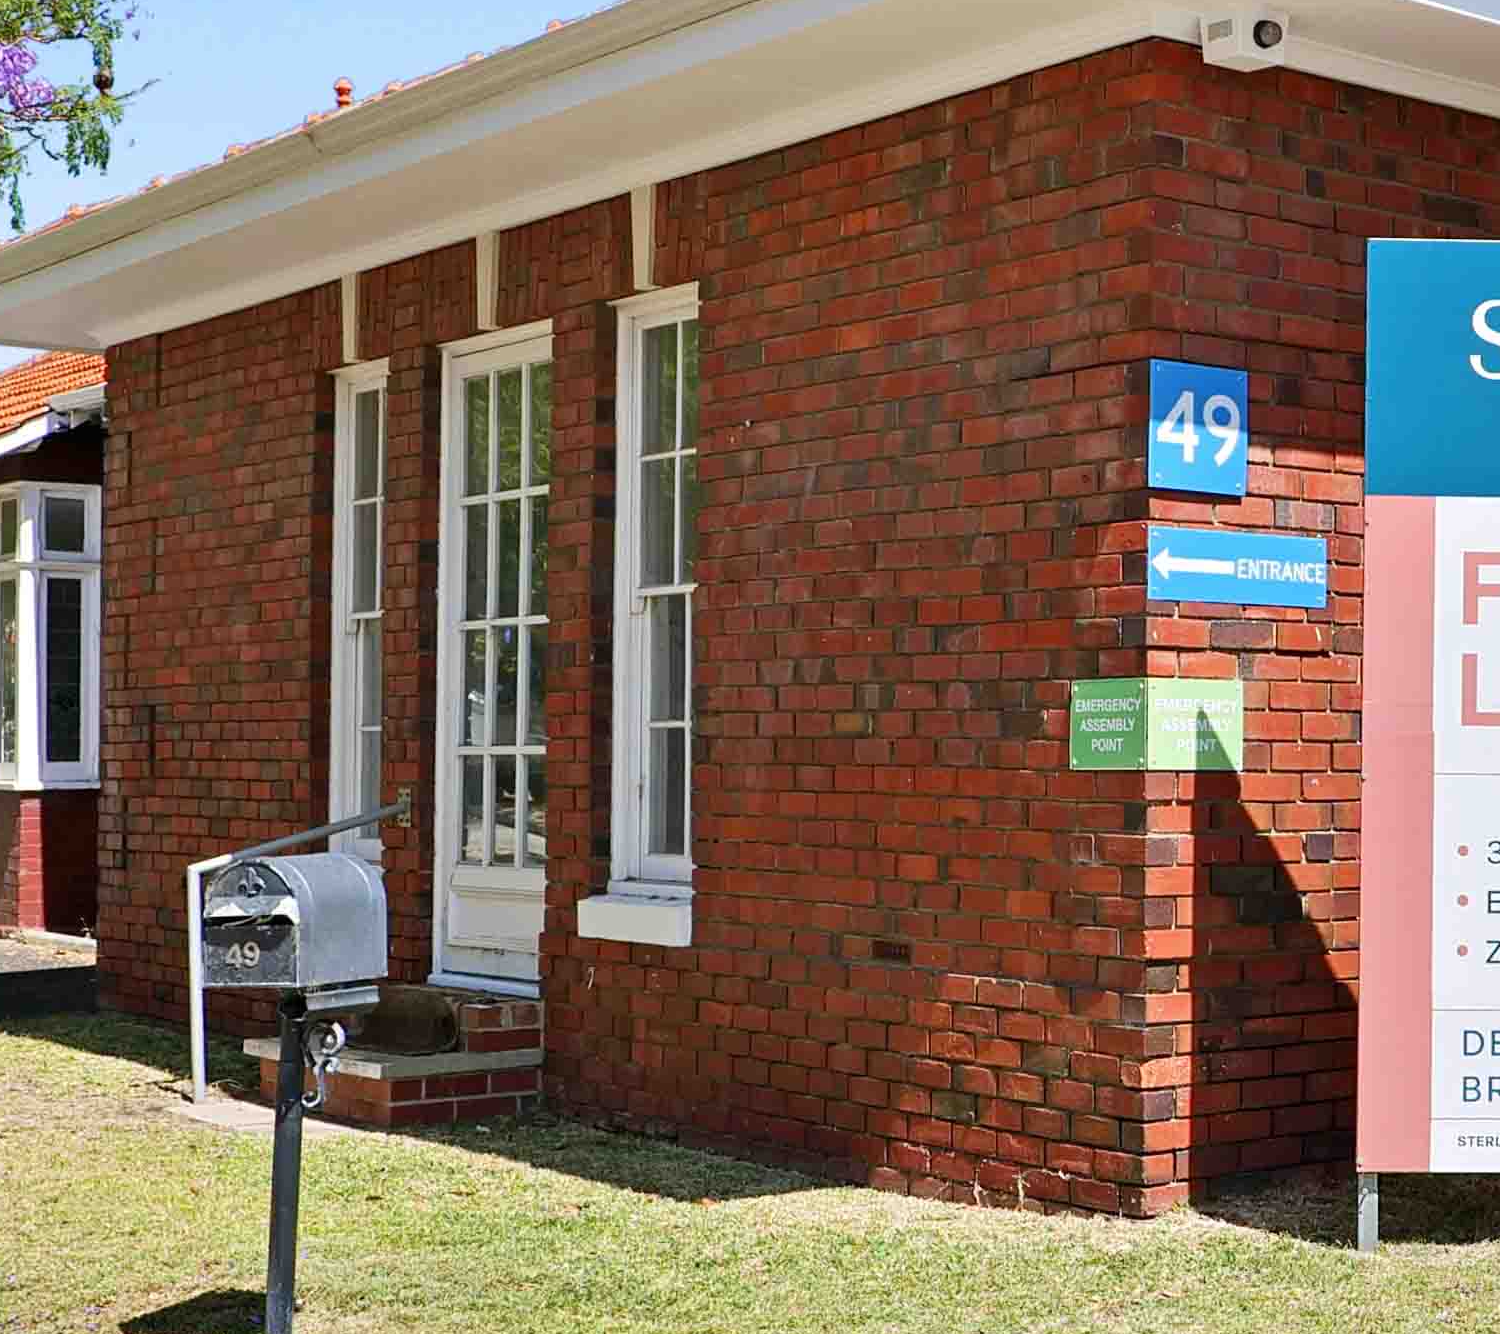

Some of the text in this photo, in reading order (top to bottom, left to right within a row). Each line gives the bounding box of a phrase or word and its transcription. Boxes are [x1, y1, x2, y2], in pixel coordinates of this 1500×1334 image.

[1156, 391, 1240, 467] 49
[1236, 557, 1326, 585] ENTRANCE
[1075, 698, 1141, 713] EMERGENCY
[1080, 717, 1135, 732] ASSEMBLY
[1091, 738, 1124, 752] POINT
[227, 941, 260, 968] 49
